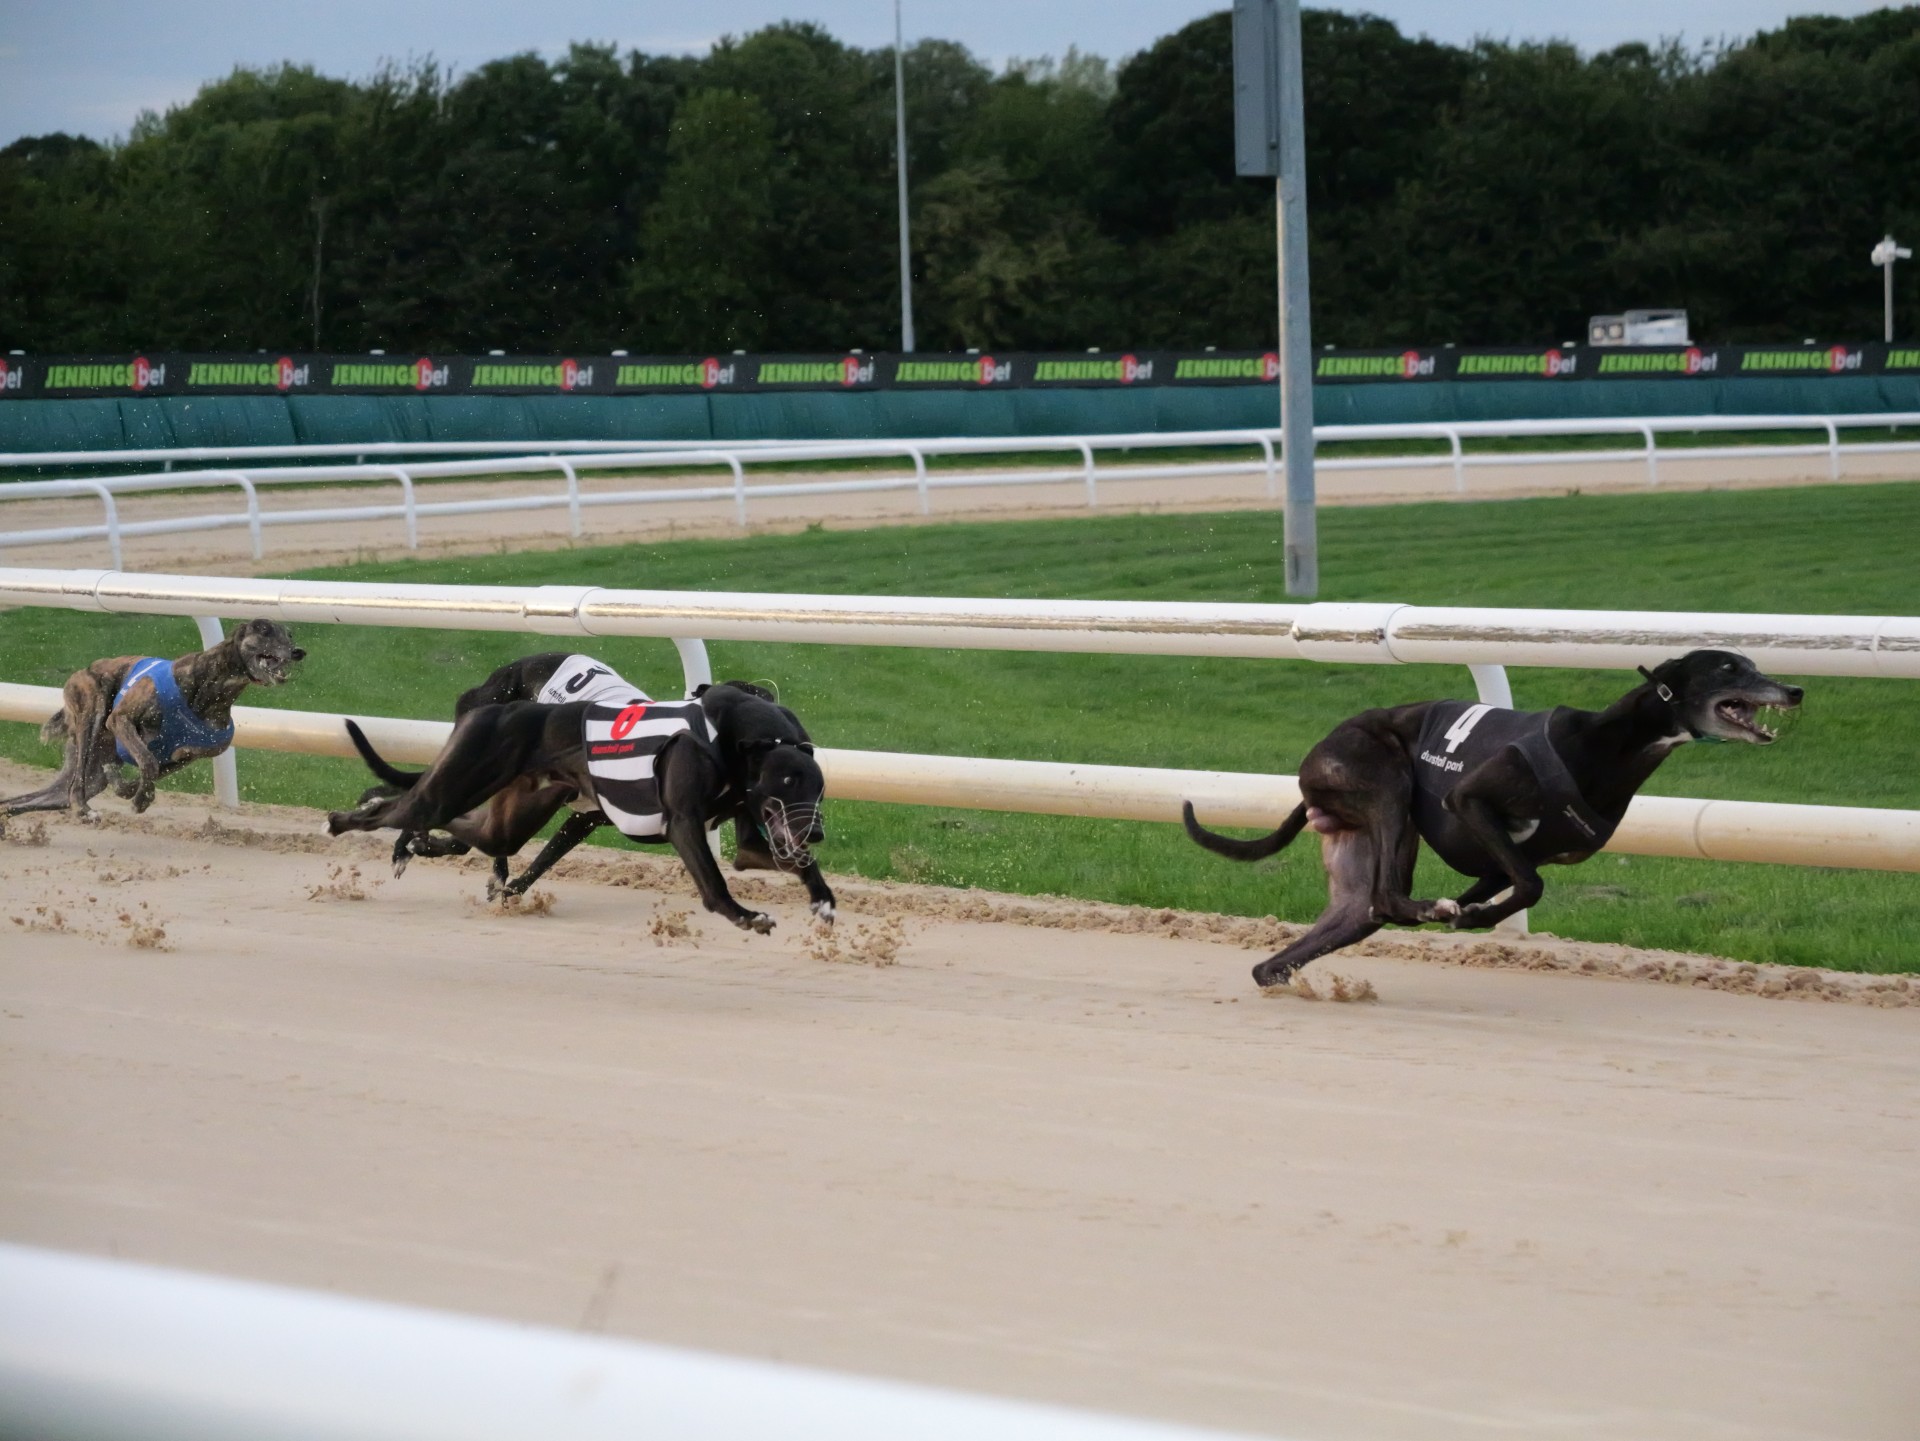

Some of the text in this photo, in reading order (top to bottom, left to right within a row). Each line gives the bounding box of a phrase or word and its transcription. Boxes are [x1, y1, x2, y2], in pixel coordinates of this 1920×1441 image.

[1444, 703, 1497, 754] 4
[1420, 750, 1464, 772] dunstall park
